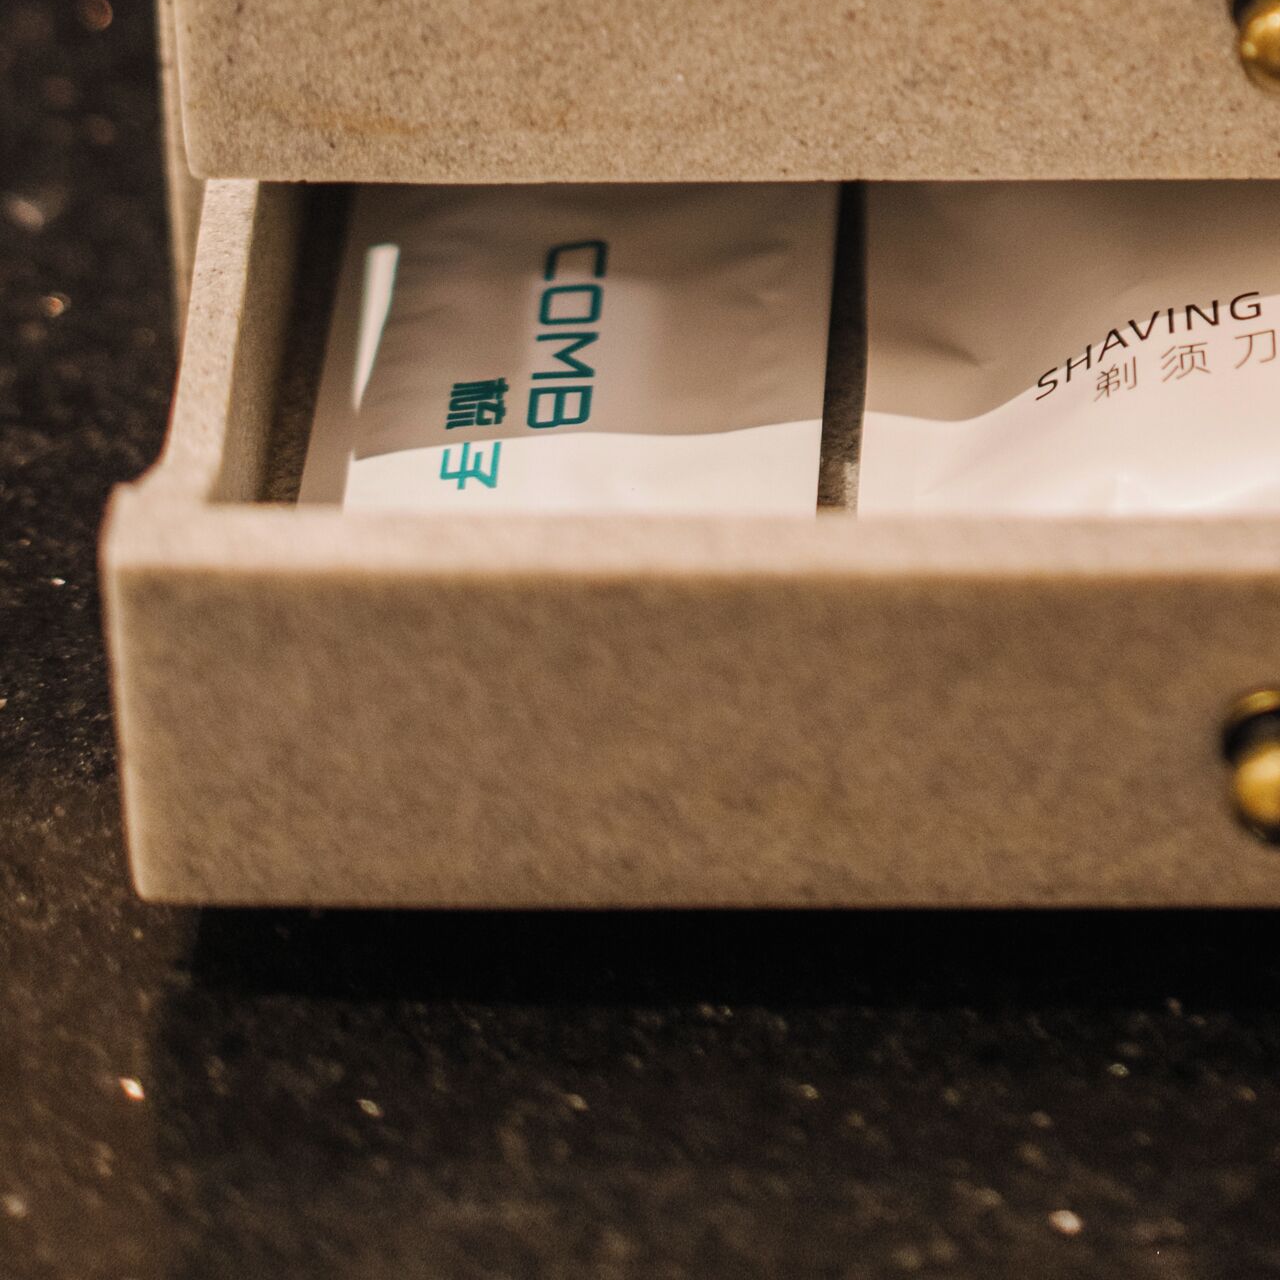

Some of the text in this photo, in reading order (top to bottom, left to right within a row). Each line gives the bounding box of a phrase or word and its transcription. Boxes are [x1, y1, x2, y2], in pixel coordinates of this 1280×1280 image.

[527, 239, 609, 430] COMB
[1034, 291, 1262, 401] SHAVING
[1093, 329, 1278, 402] 剃须刀
[439, 376, 509, 490] 梳子
